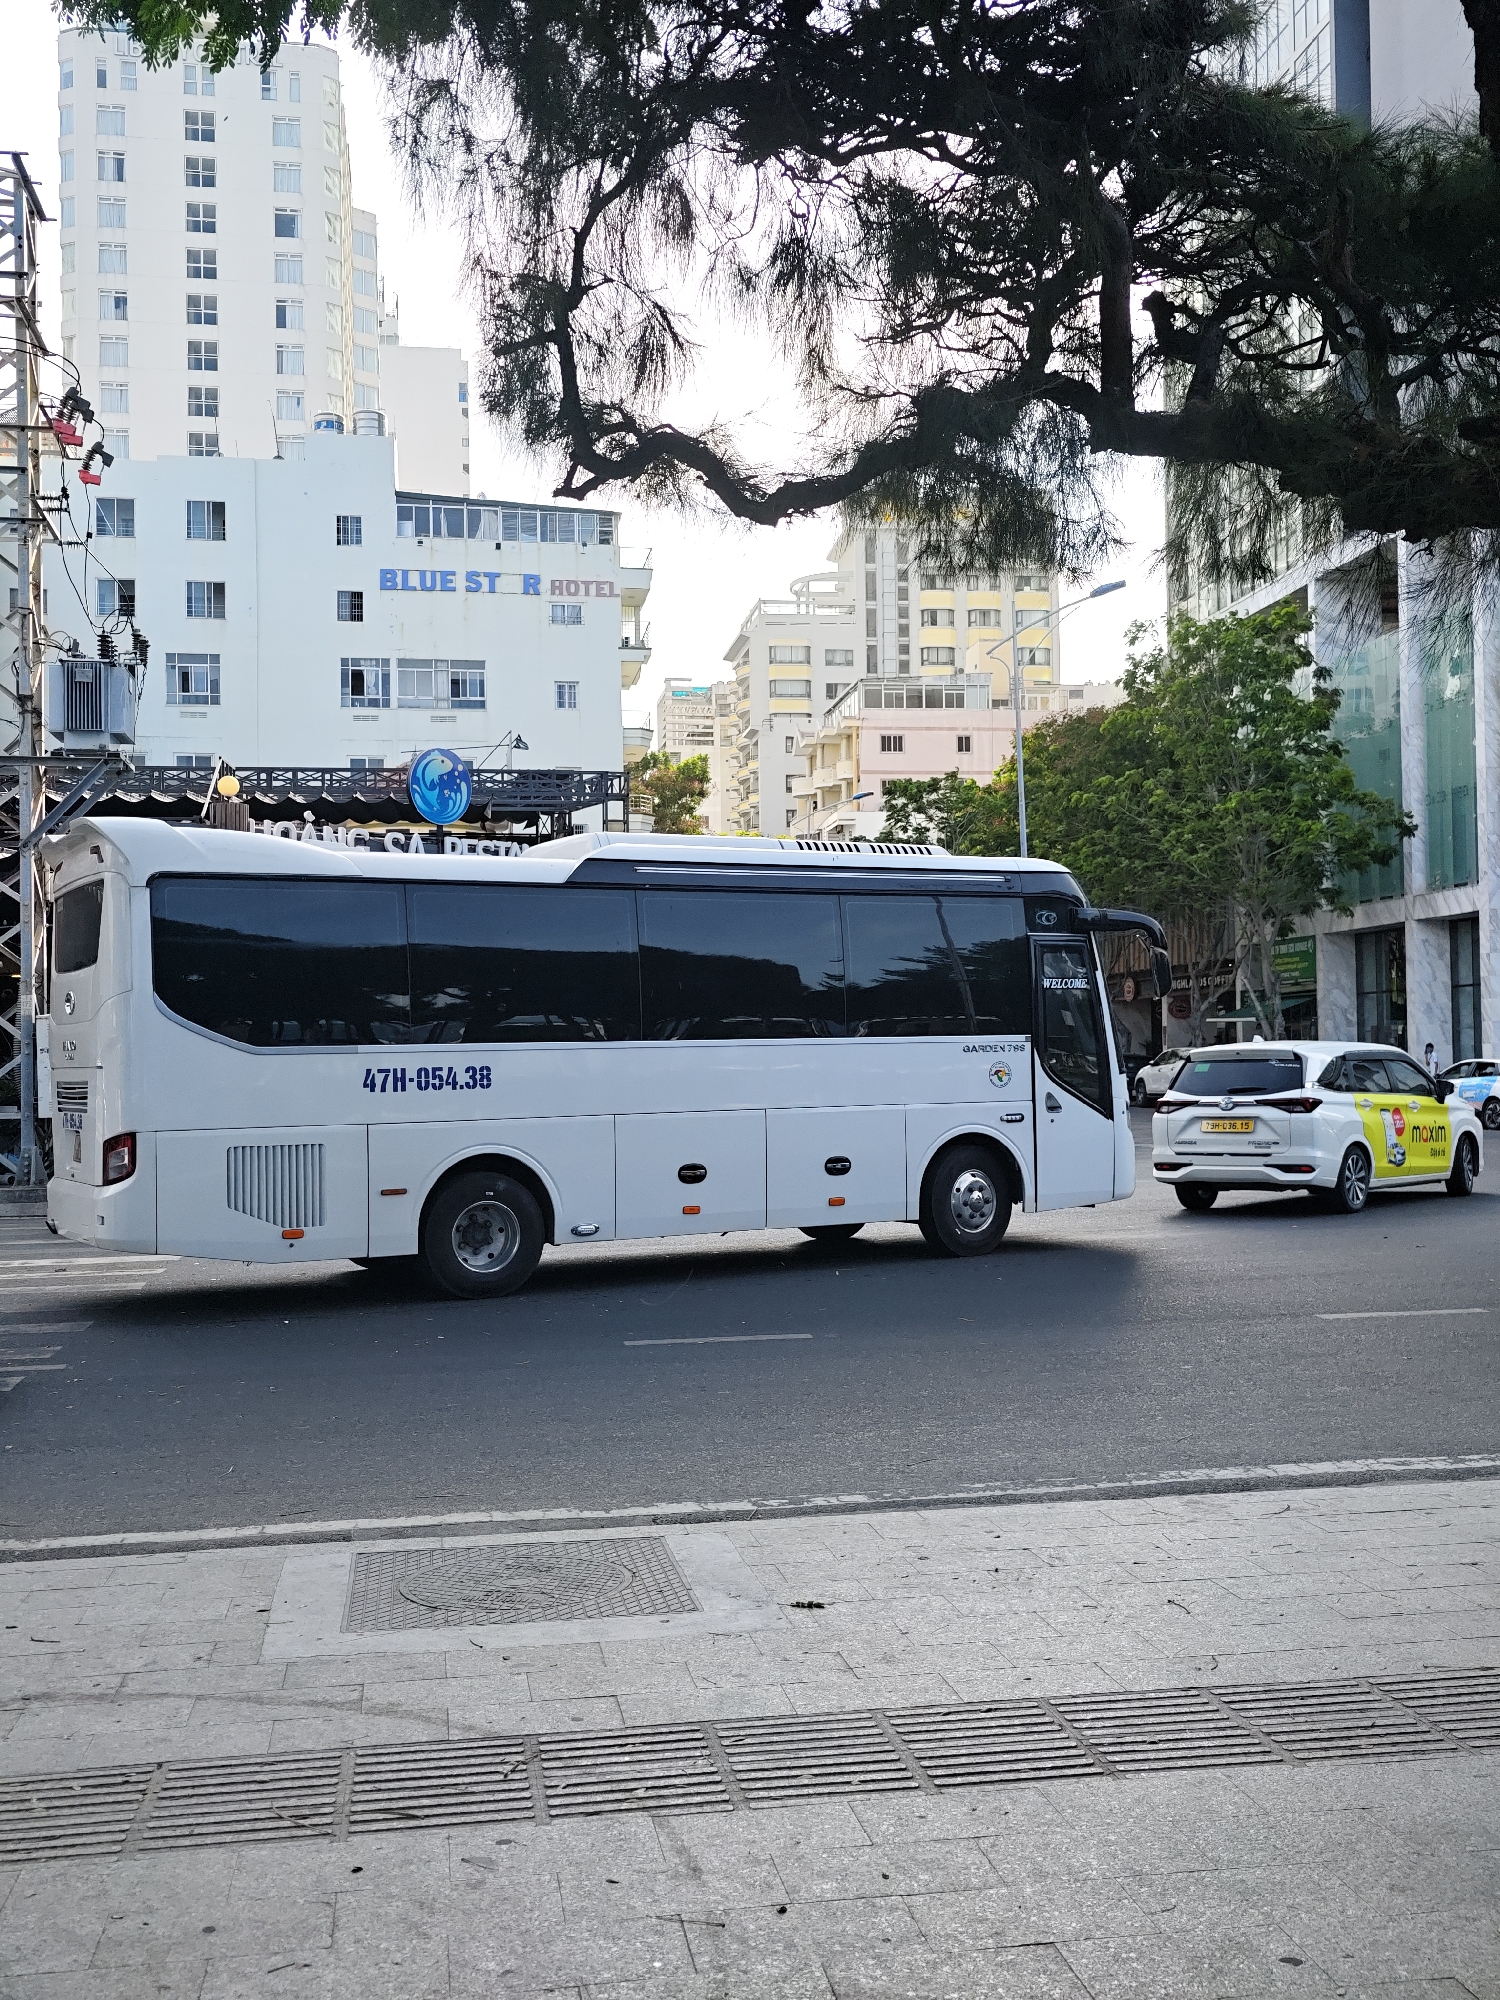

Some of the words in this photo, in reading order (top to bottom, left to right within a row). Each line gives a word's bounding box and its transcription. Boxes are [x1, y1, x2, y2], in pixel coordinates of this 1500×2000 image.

[114, 34, 190, 62] LIBY
[193, 42, 284, 68] CTRL
[380, 569, 456, 592] BLUE
[465, 571, 541, 595] STR
[550, 580, 620, 597] HOTEL
[444, 836, 531, 857] RESTA
[1043, 978, 1089, 989] WELCOME
[963, 1044, 1006, 1053] GARDEN
[363, 1066, 492, 1092] 47H-054.38
[1412, 1120, 1447, 1144] maxim
